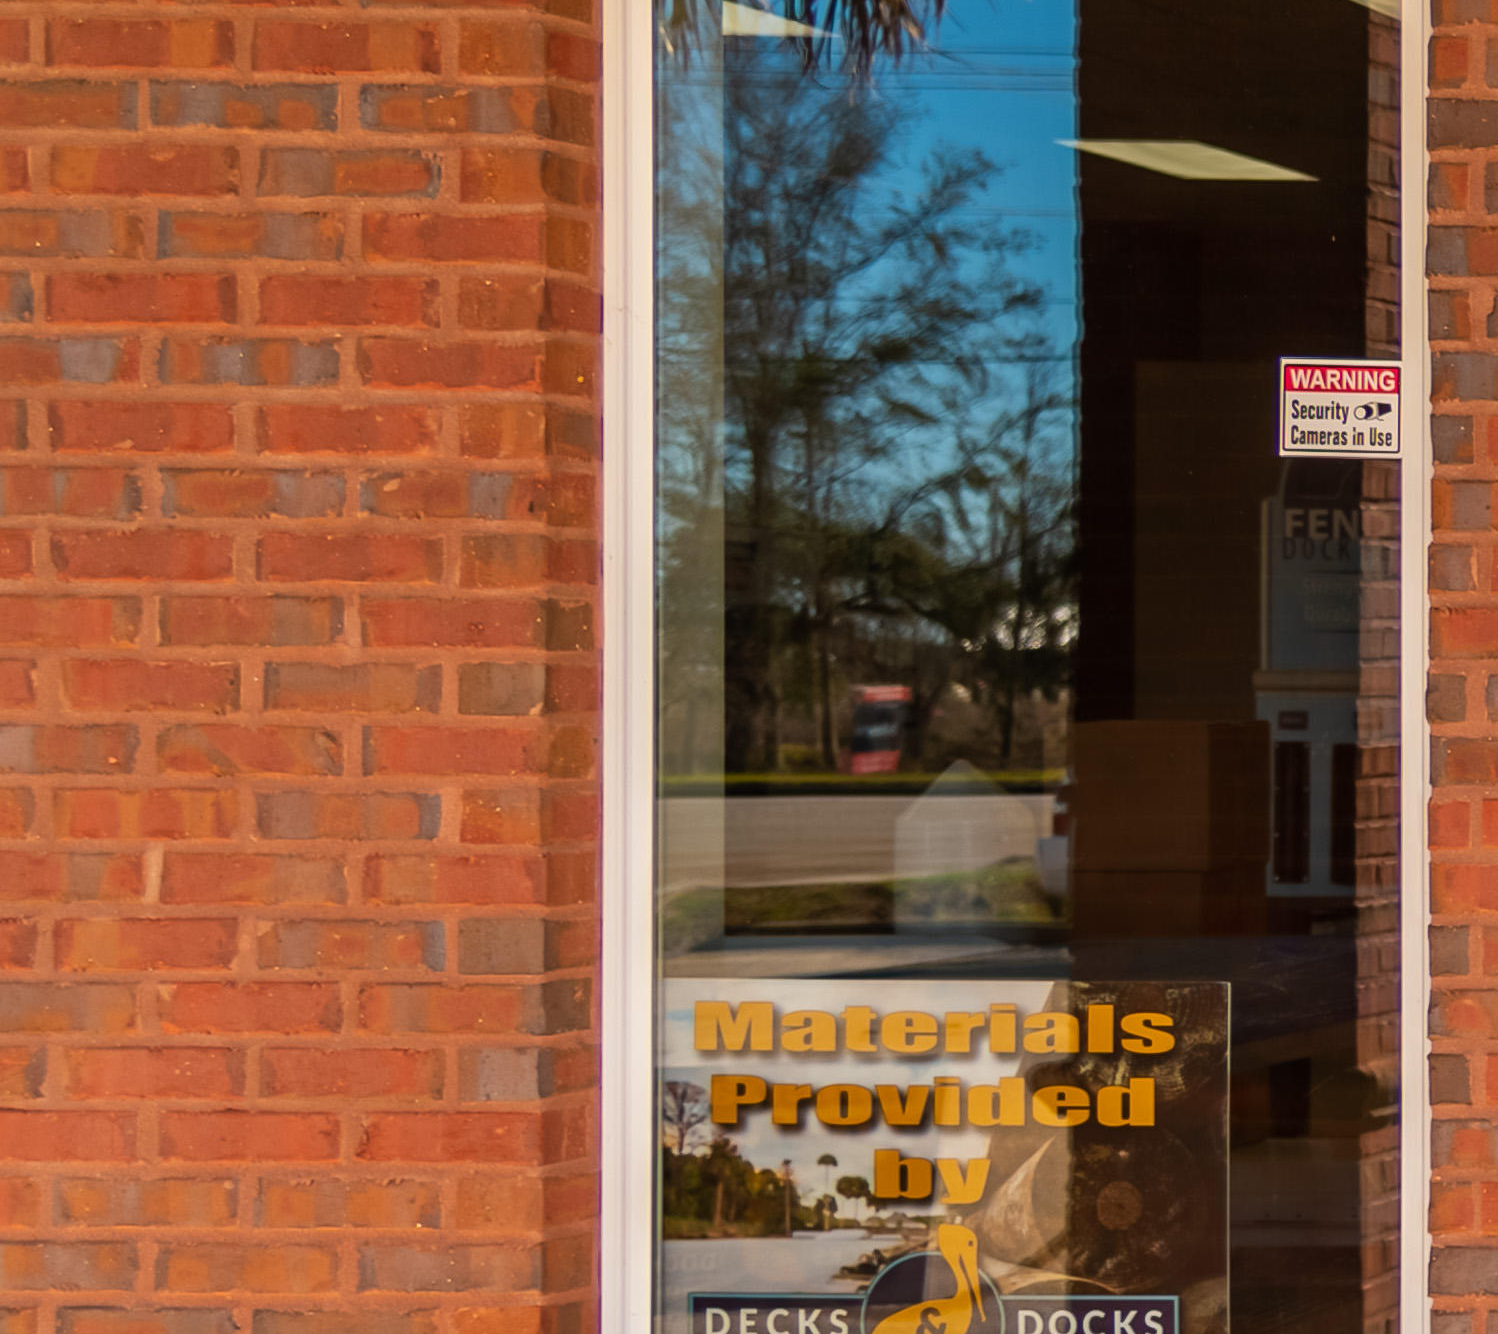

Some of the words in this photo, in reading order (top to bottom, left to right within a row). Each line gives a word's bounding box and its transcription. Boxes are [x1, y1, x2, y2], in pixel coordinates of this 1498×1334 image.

[1289, 368, 1396, 391] WARNING
[1291, 399, 1350, 425] Security
[1290, 424, 1348, 446] Cameras
[1369, 427, 1393, 447] Use
[693, 999, 1177, 1055] Materials
[710, 1074, 1156, 1128] Provided
[873, 1148, 991, 1206] by
